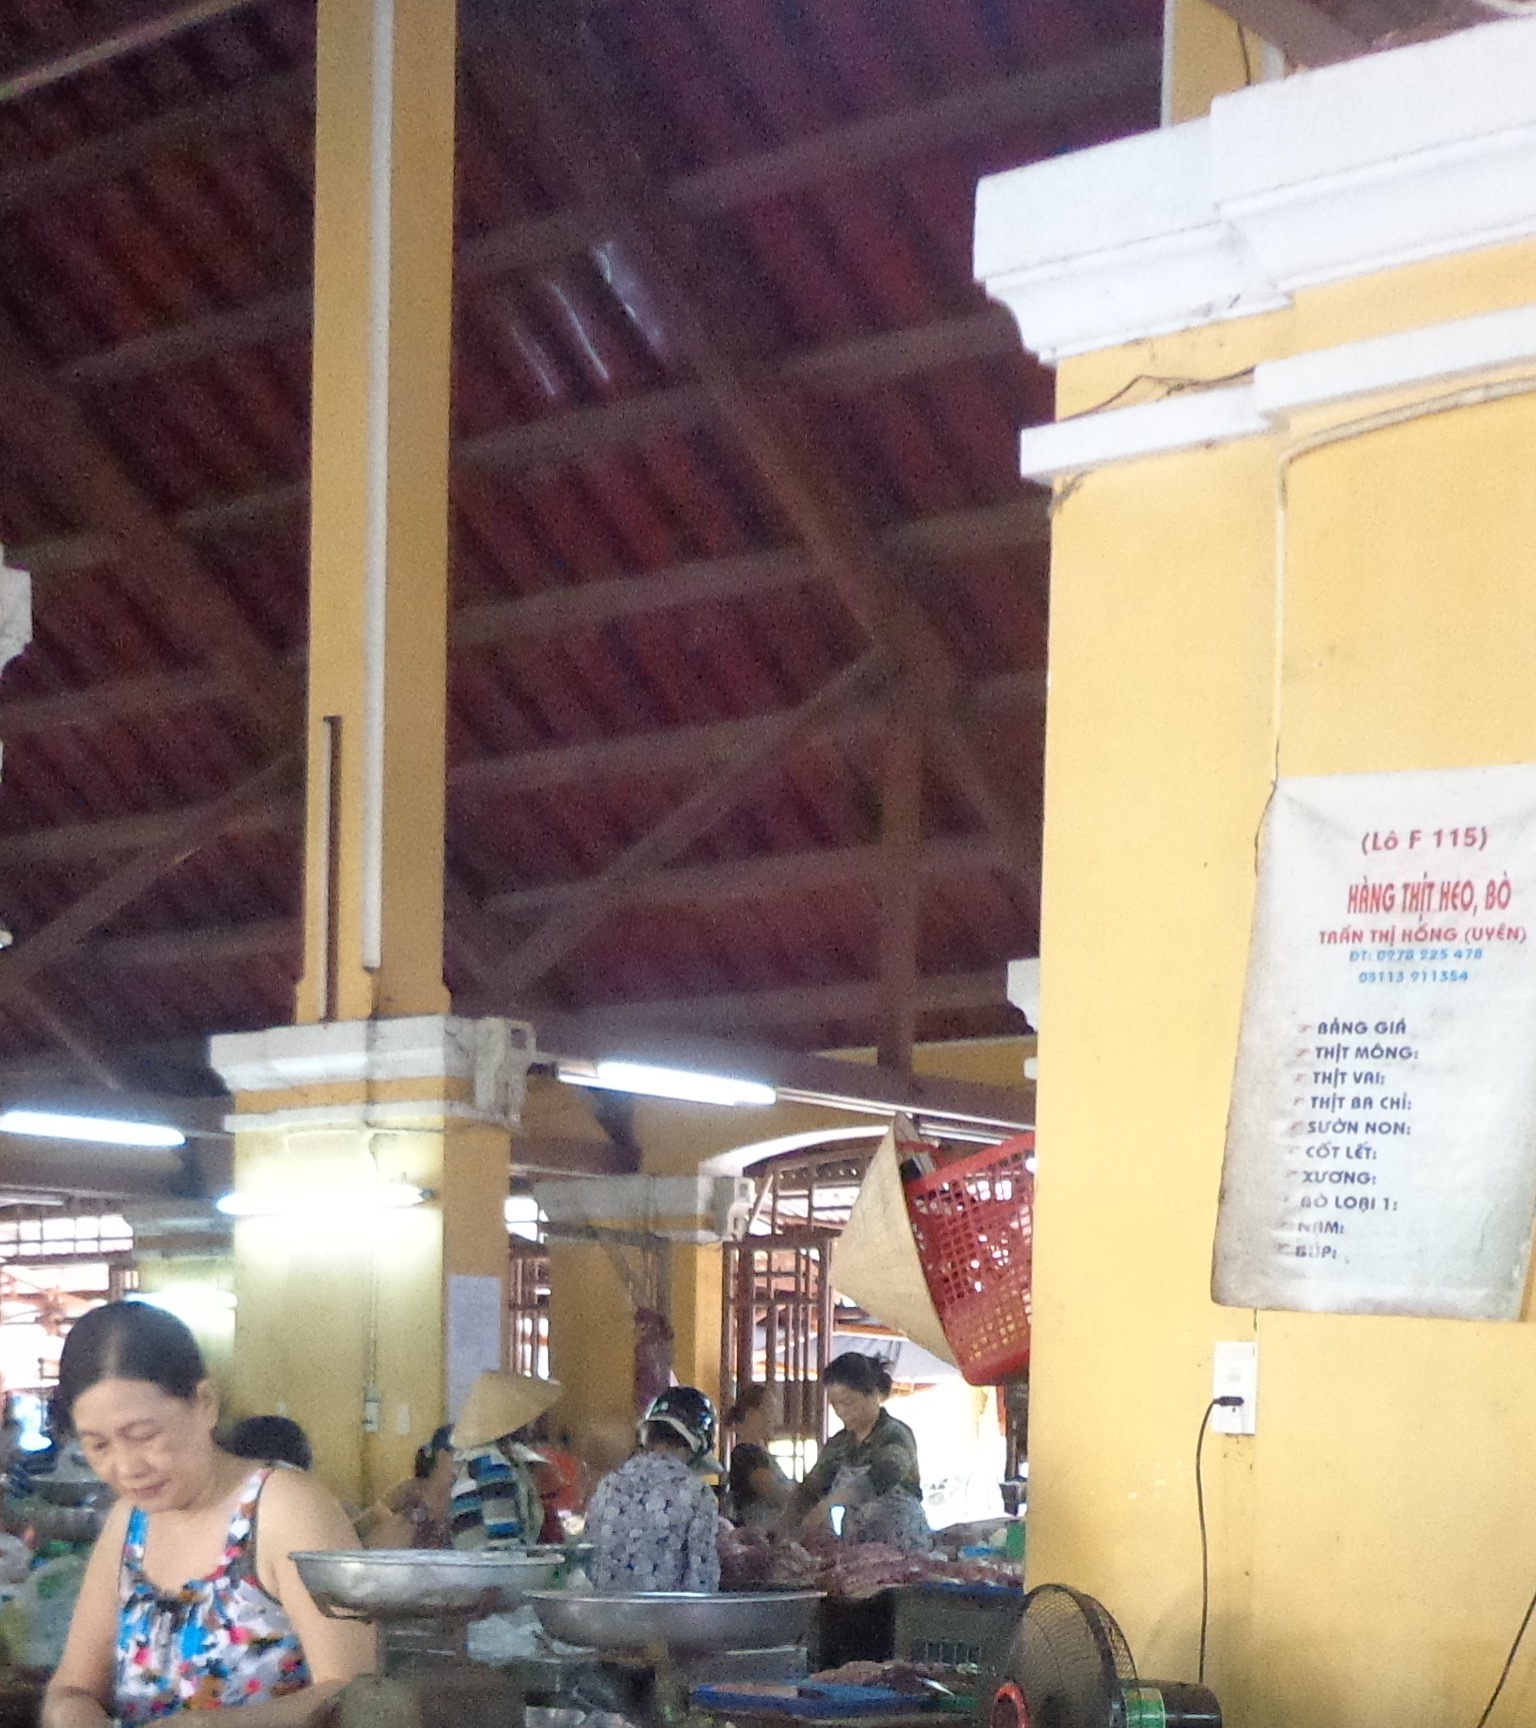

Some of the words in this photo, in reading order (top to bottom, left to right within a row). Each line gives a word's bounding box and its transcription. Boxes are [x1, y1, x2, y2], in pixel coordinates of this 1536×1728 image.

[1362, 829, 1398, 855] (Lô
[1409, 829, 1421, 849] F
[1433, 826, 1488, 851] 115)
[1347, 875, 1395, 914] HÀNG
[1401, 870, 1434, 921] THỊT
[1439, 879, 1477, 916] HEO,
[1485, 870, 1511, 910] BÒ
[1370, 925, 1396, 946] THỊ
[1317, 1017, 1368, 1035] BẢNG
[1374, 1017, 1407, 1035] GIÁ
[1315, 1042, 1350, 1063] THỊT
[1354, 1042, 1418, 1060] MÔNG:
[1313, 1067, 1348, 1088] THỊT
[1353, 1071, 1385, 1085] VAI:
[1310, 1092, 1345, 1113] THỊT
[1351, 1096, 1373, 1110] BA
[1307, 1117, 1359, 1134] SƯỜN
[1364, 1121, 1411, 1136] NON:
[1305, 1140, 1340, 1159] CỐT
[1346, 1141, 1377, 1160] LẾT:
[1302, 1170, 1376, 1186] XƯƠNG:
[1334, 1195, 1376, 1213] LOẠI
[1383, 1197, 1398, 1212] 1:
